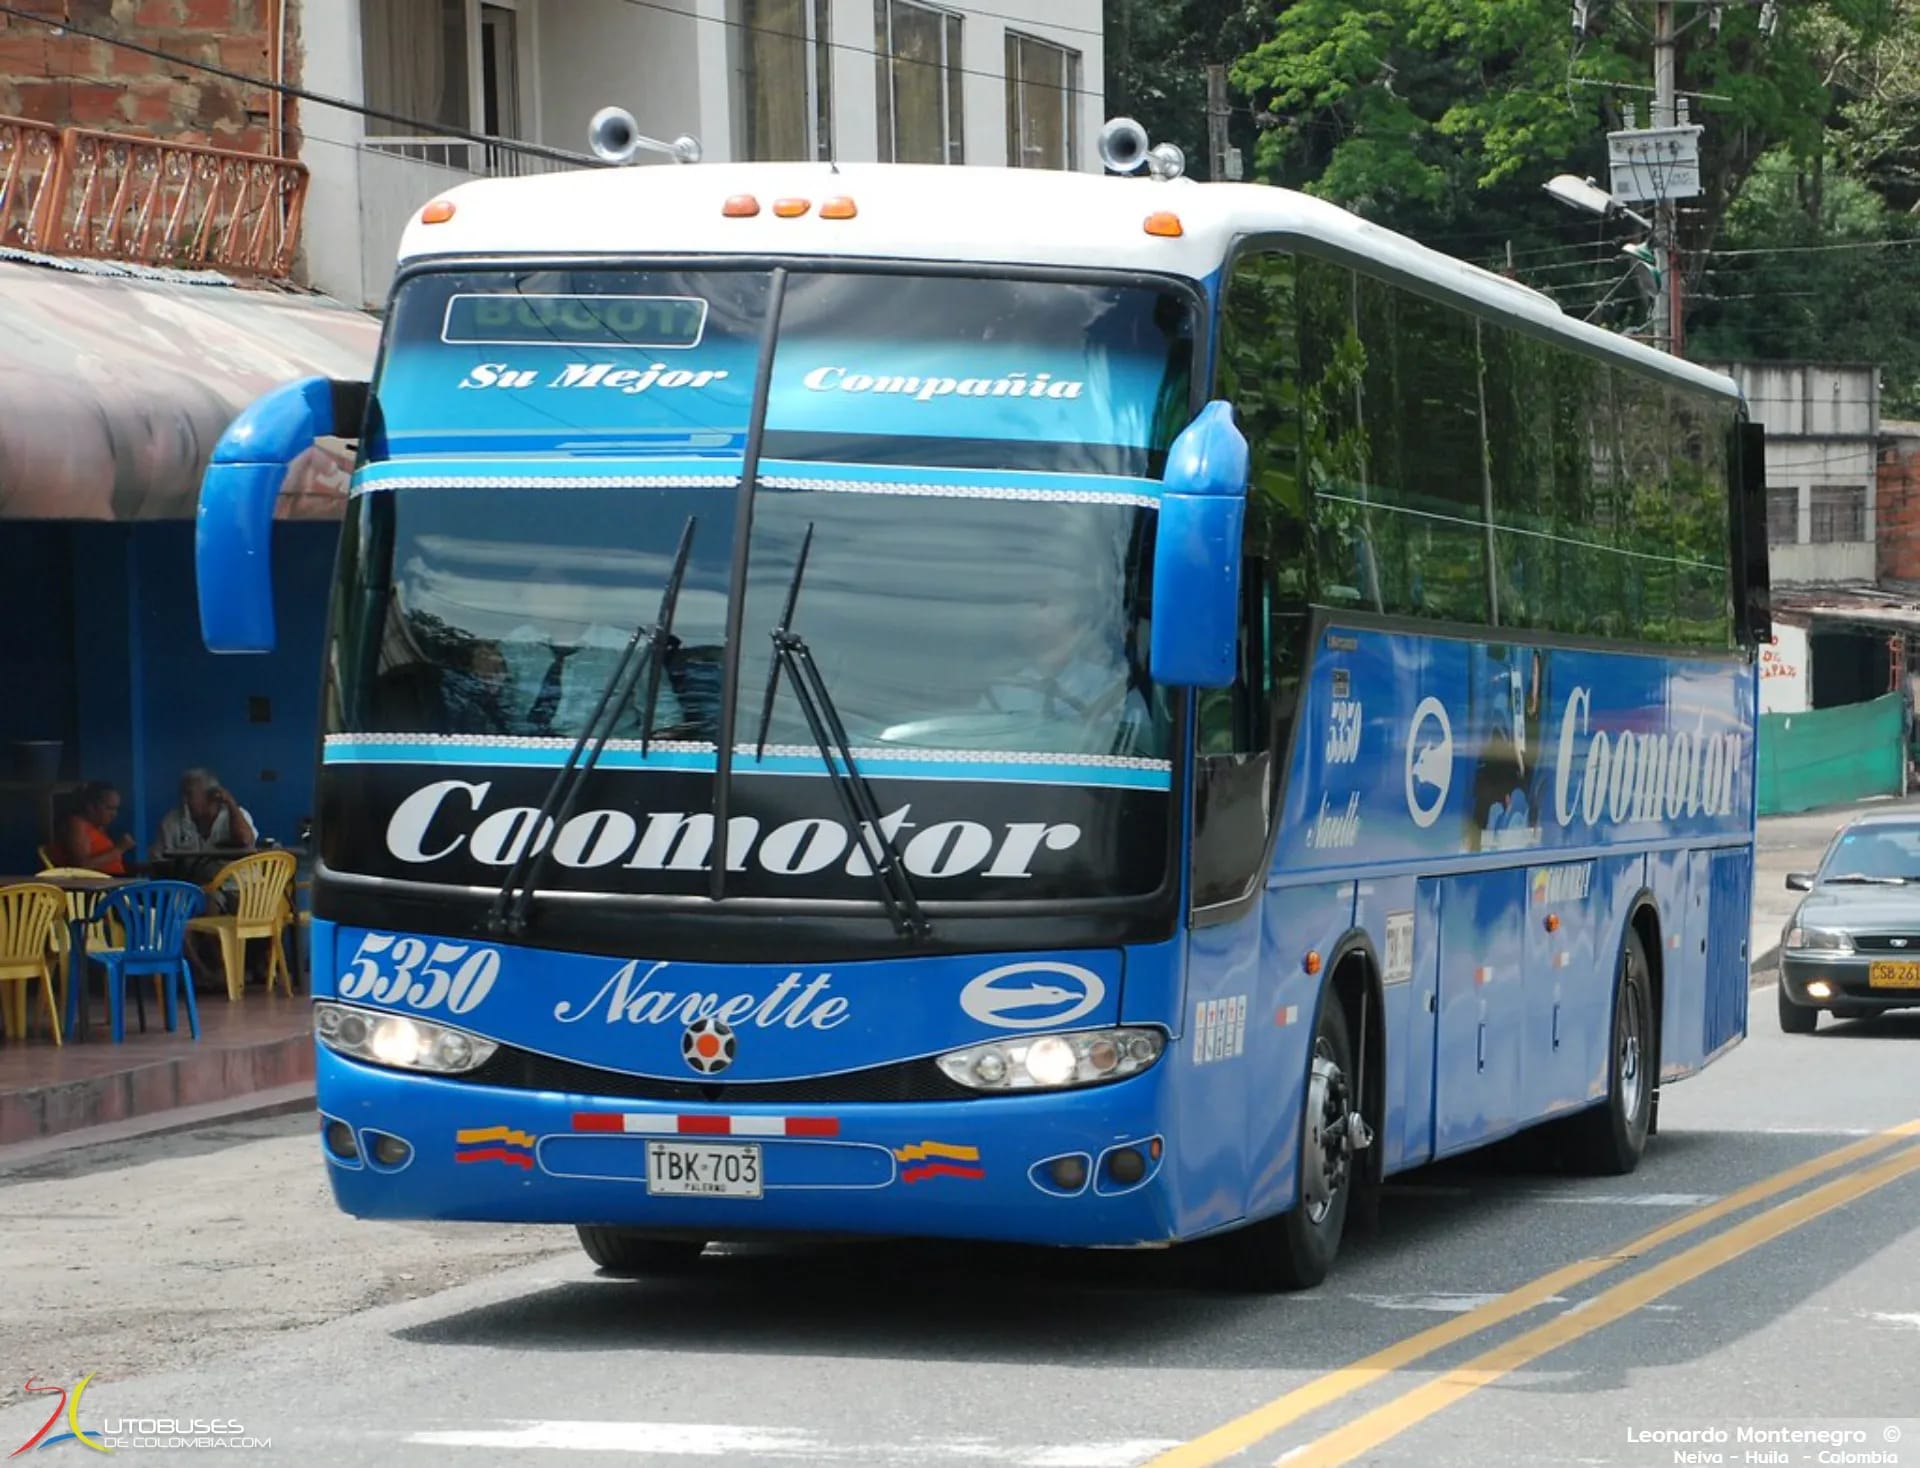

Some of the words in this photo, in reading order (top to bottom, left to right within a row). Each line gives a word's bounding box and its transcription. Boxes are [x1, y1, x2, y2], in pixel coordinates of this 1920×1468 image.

[458, 363, 538, 388] Su
[547, 363, 729, 394] Mejor
[1325, 700, 1362, 764] 5350
[1555, 686, 1742, 827] Coomotor
[386, 780, 1081, 880] Coomotor
[338, 932, 502, 1015] 5350
[554, 960, 849, 1030] Navette
